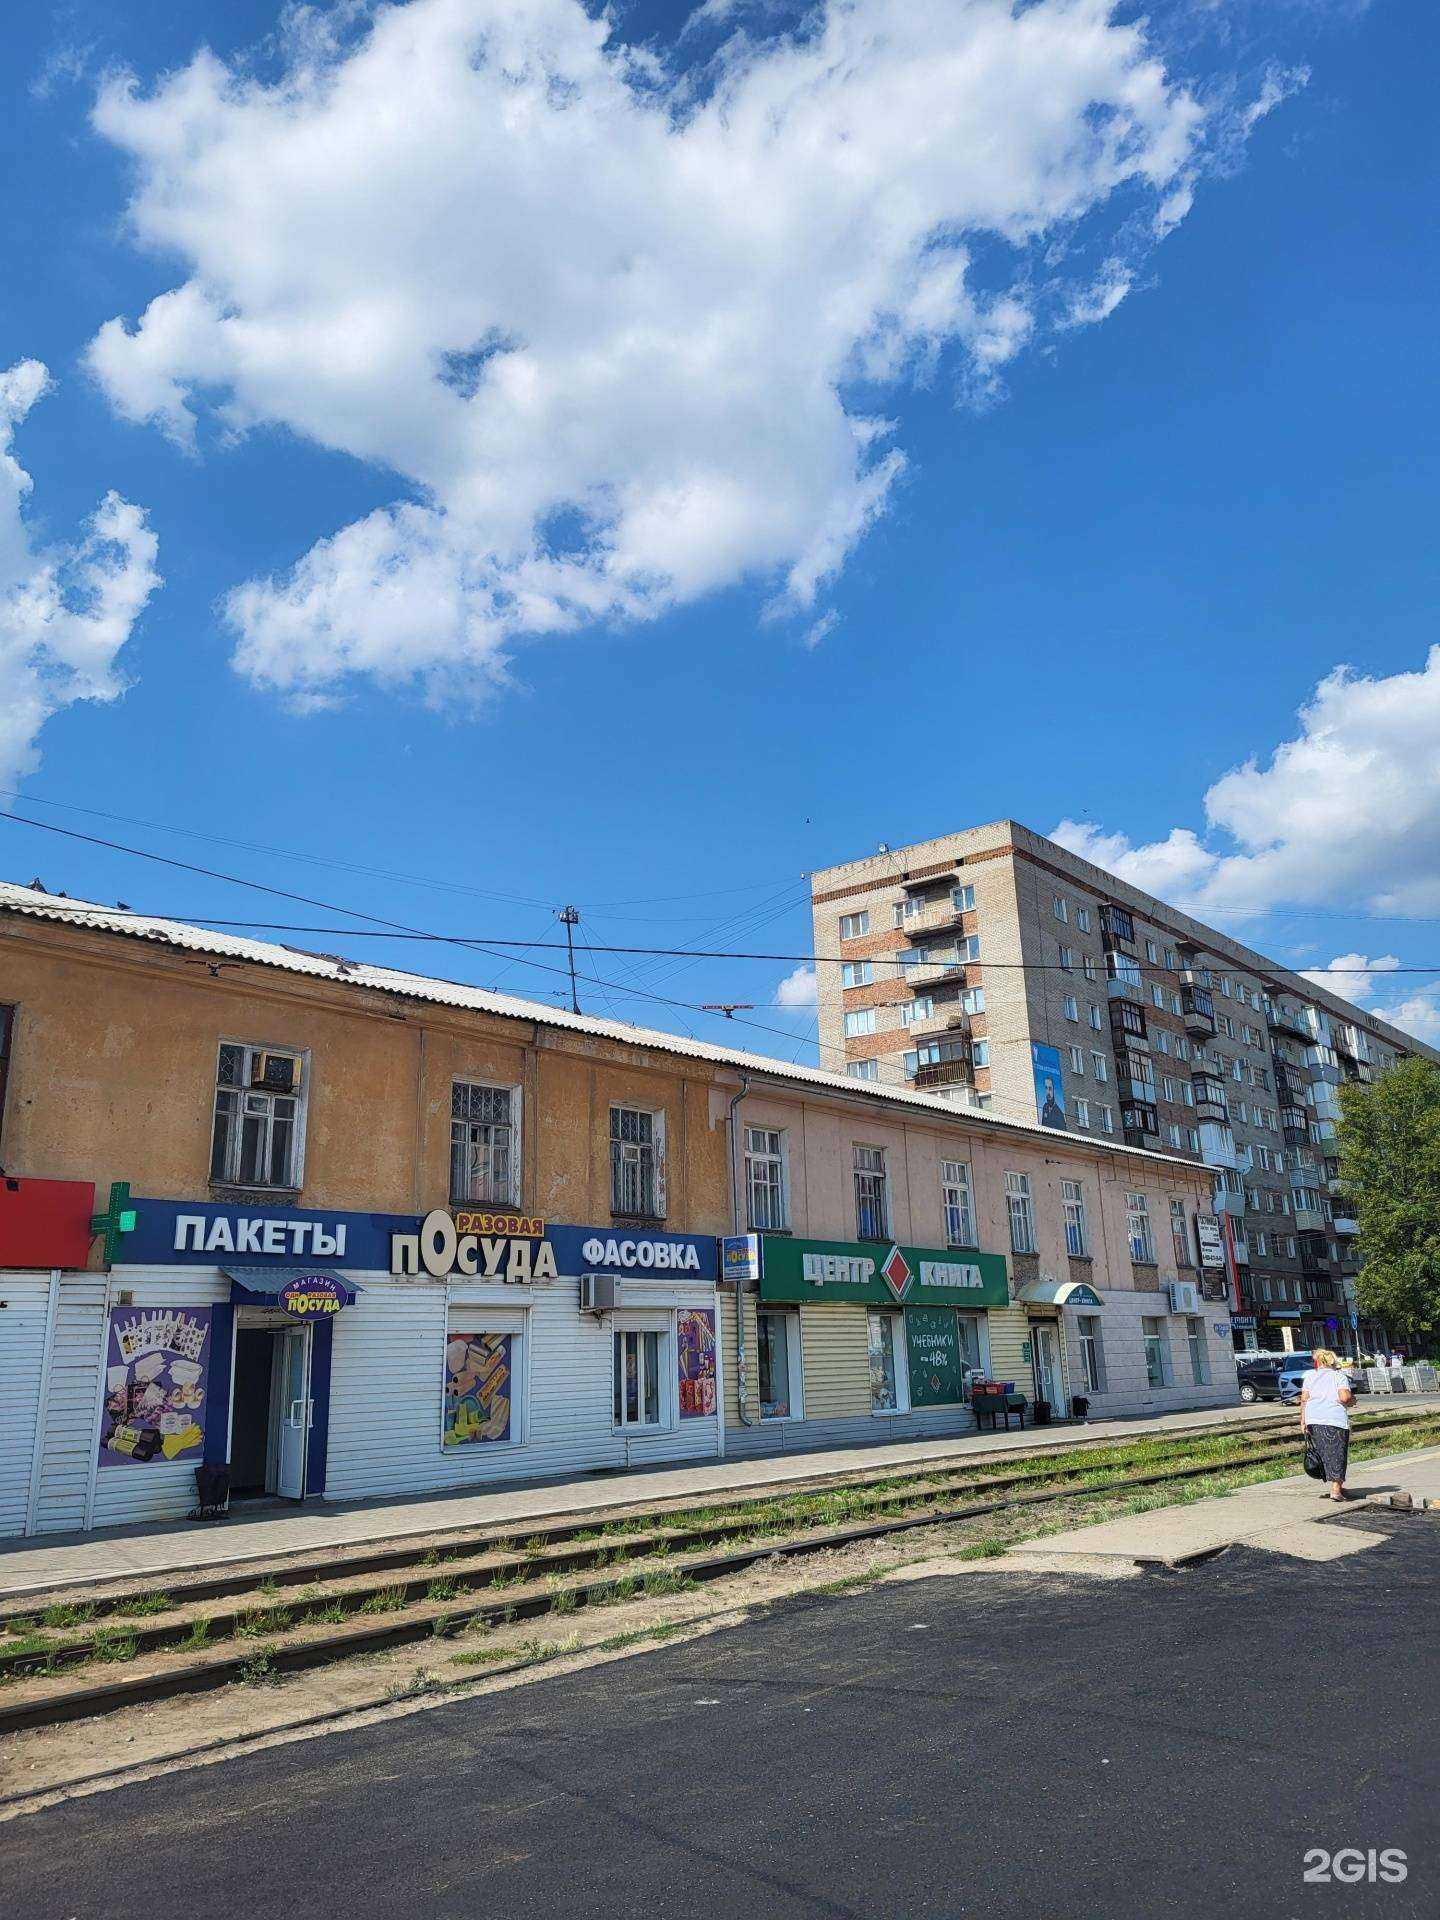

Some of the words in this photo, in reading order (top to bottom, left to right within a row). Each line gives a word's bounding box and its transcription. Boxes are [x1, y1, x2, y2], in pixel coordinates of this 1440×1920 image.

[174, 1215, 346, 1256] ПАКЕТЫ
[458, 1213, 543, 1235] РАЗОВАЯ
[392, 1209, 558, 1283] ПОСУДА
[582, 1238, 700, 1270] ФАСОВКА
[293, 1277, 336, 1291] МАГАЗИН
[803, 1253, 875, 1286] ЦЕНТР
[920, 1261, 984, 1288] КНИГА
[288, 1294, 340, 1313] ПОСУДА
[911, 1335, 953, 1348] УЧЕБНИКИ
